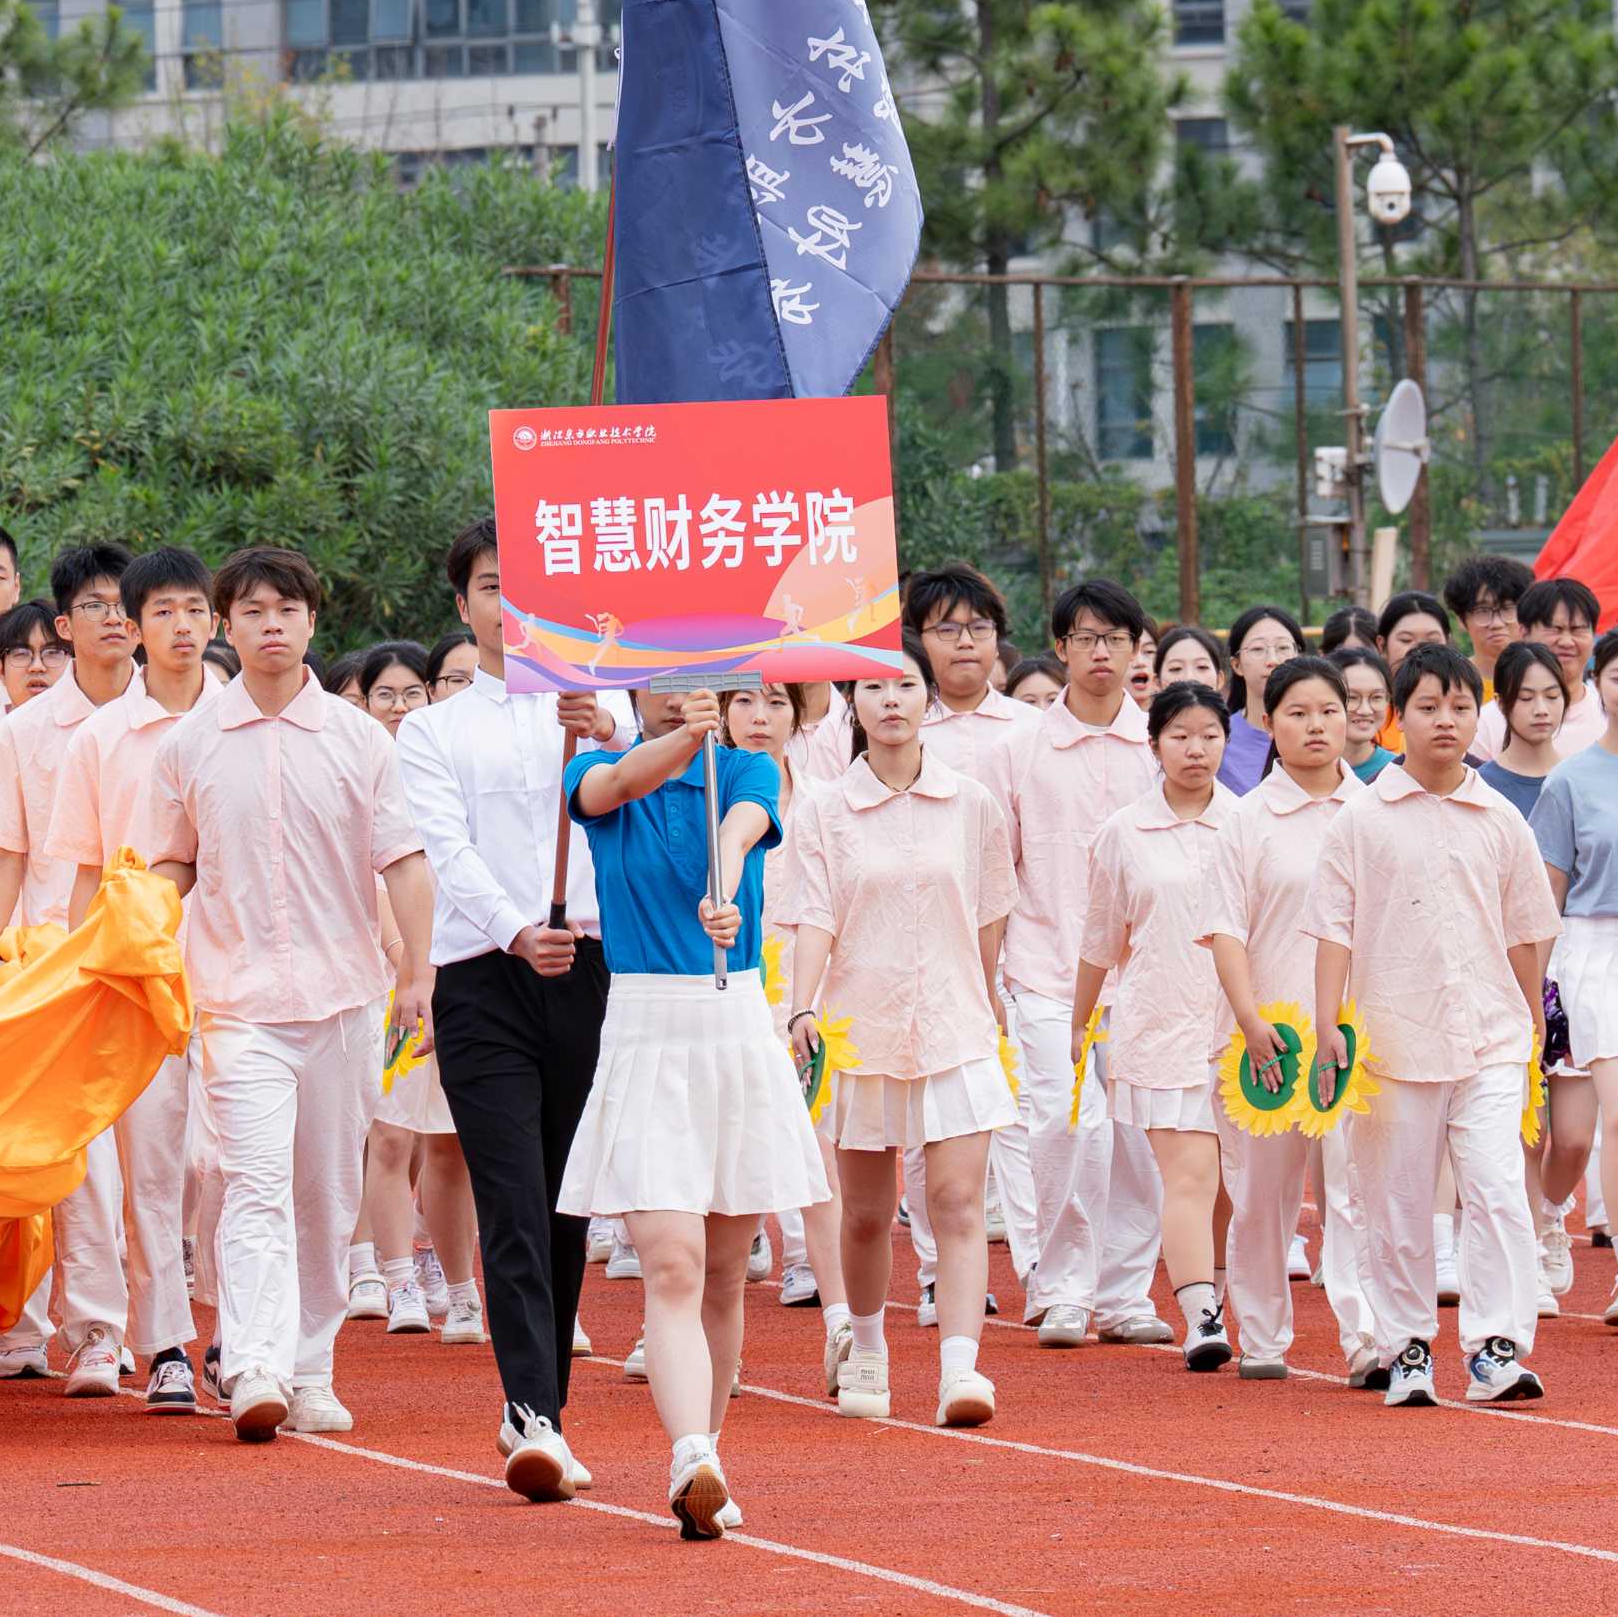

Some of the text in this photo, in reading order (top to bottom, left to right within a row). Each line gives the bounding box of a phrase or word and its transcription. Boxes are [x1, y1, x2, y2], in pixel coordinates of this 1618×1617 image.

[534, 488, 858, 576] 智慧财务学院
